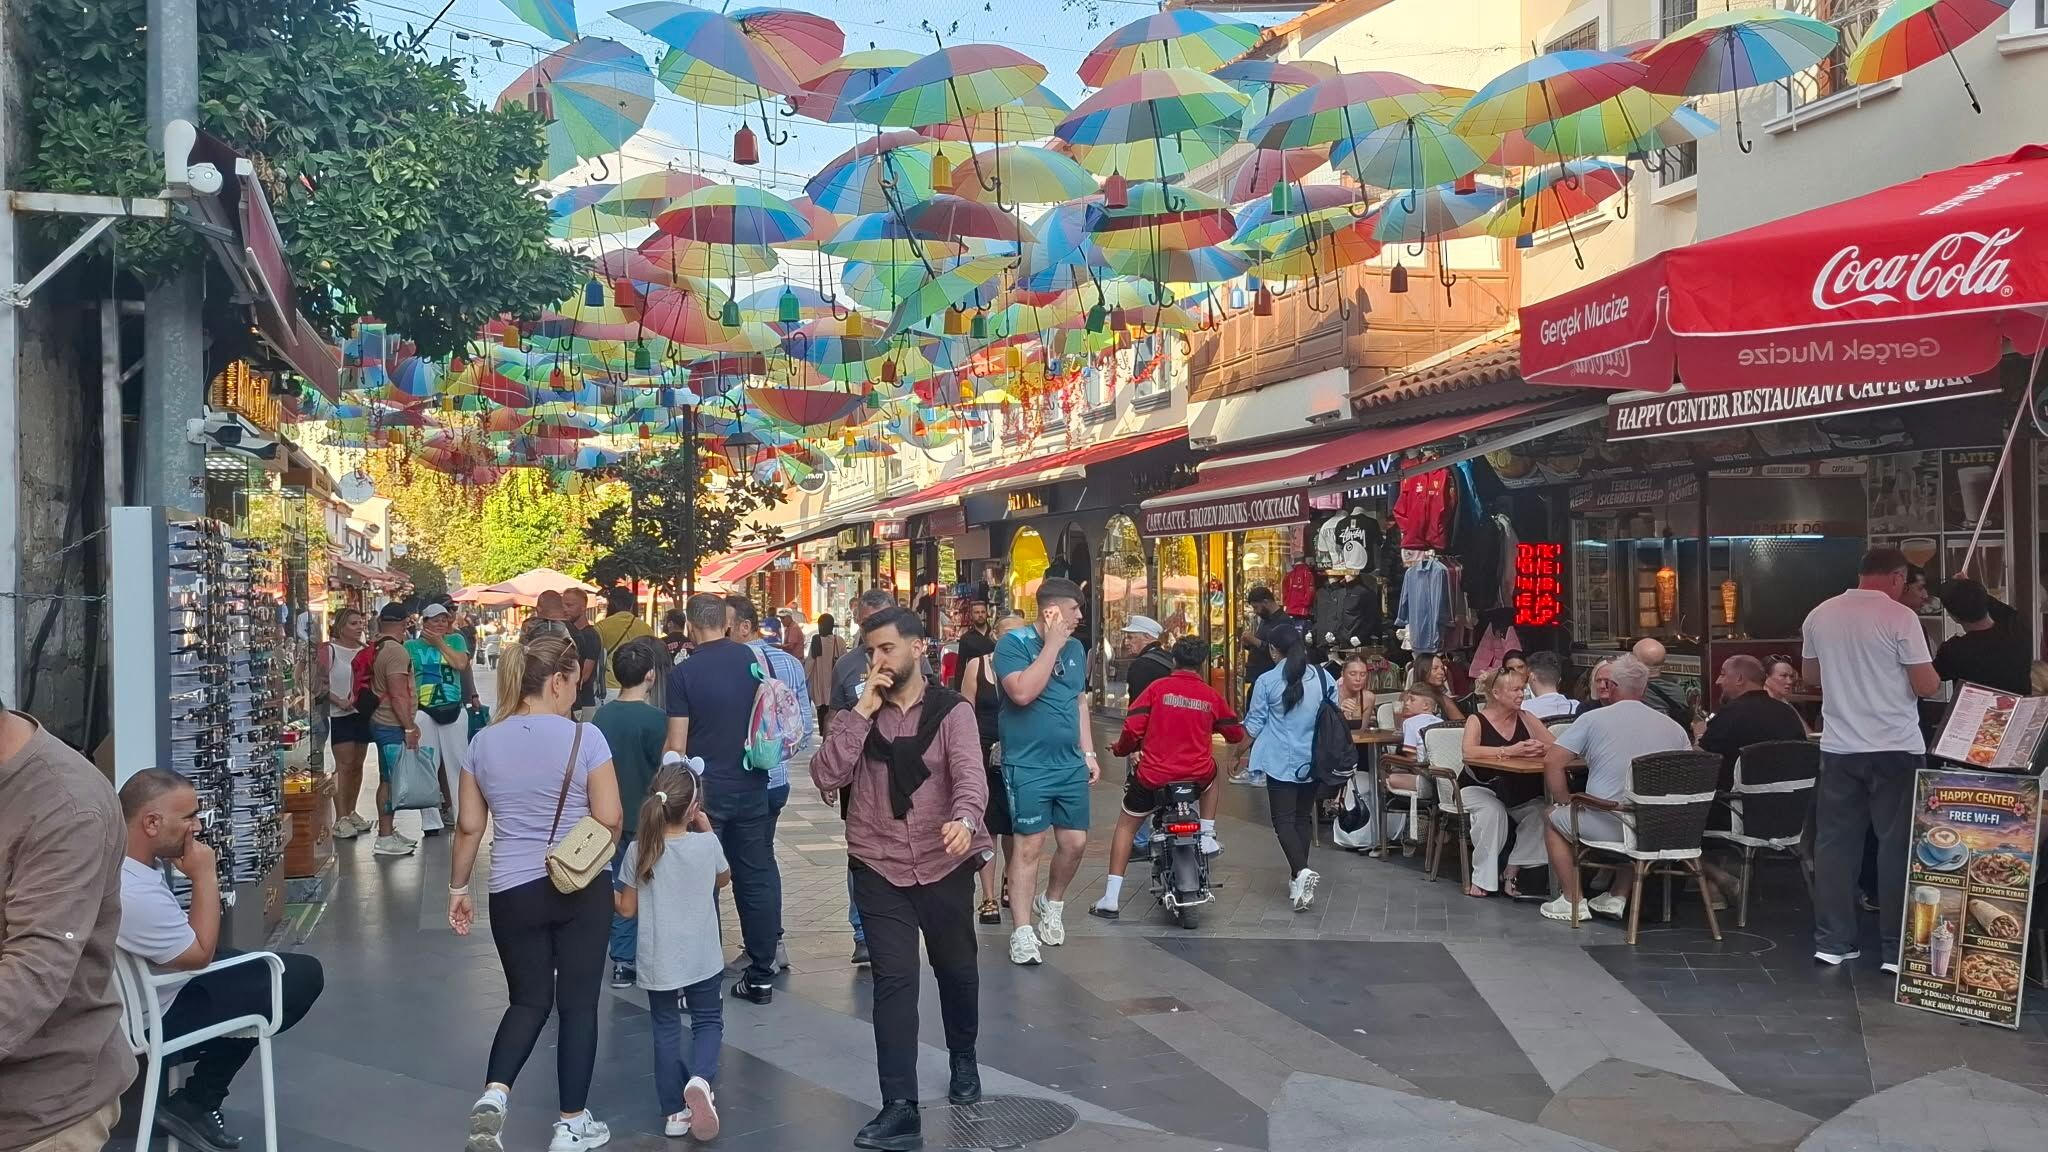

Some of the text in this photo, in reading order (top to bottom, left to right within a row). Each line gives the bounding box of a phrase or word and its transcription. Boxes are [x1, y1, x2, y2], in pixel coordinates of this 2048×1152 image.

[1812, 226, 2025, 310] Coca-Cola
[1540, 293, 1629, 346] Gerçek Mucize
[1616, 402, 1665, 431] HAPPY
[1666, 394, 1730, 425] CENTER
[1949, 452, 1995, 464] LATTE
[1163, 510, 1186, 531] LATTE
[1190, 506, 1218, 528] FROZEN
[1219, 502, 1248, 525] DRINKS
[1251, 494, 1300, 522] COCKTAILS
[1940, 790, 2015, 807] HAPPY CENTER
[1949, 810, 2000, 825] FREE WI-FI
[1924, 874, 1960, 885] CAPPUCCINO
[1977, 938, 2009, 949] SHOARMA
[1910, 962, 1926, 972] BEER
[1912, 978, 1943, 989] WE ACCEPT
[1977, 988, 1997, 999] PIZZA
[1920, 998, 1991, 1018] TAKE AWAY AVAILABLE
[1997, 1004, 2012, 1012] CARD
